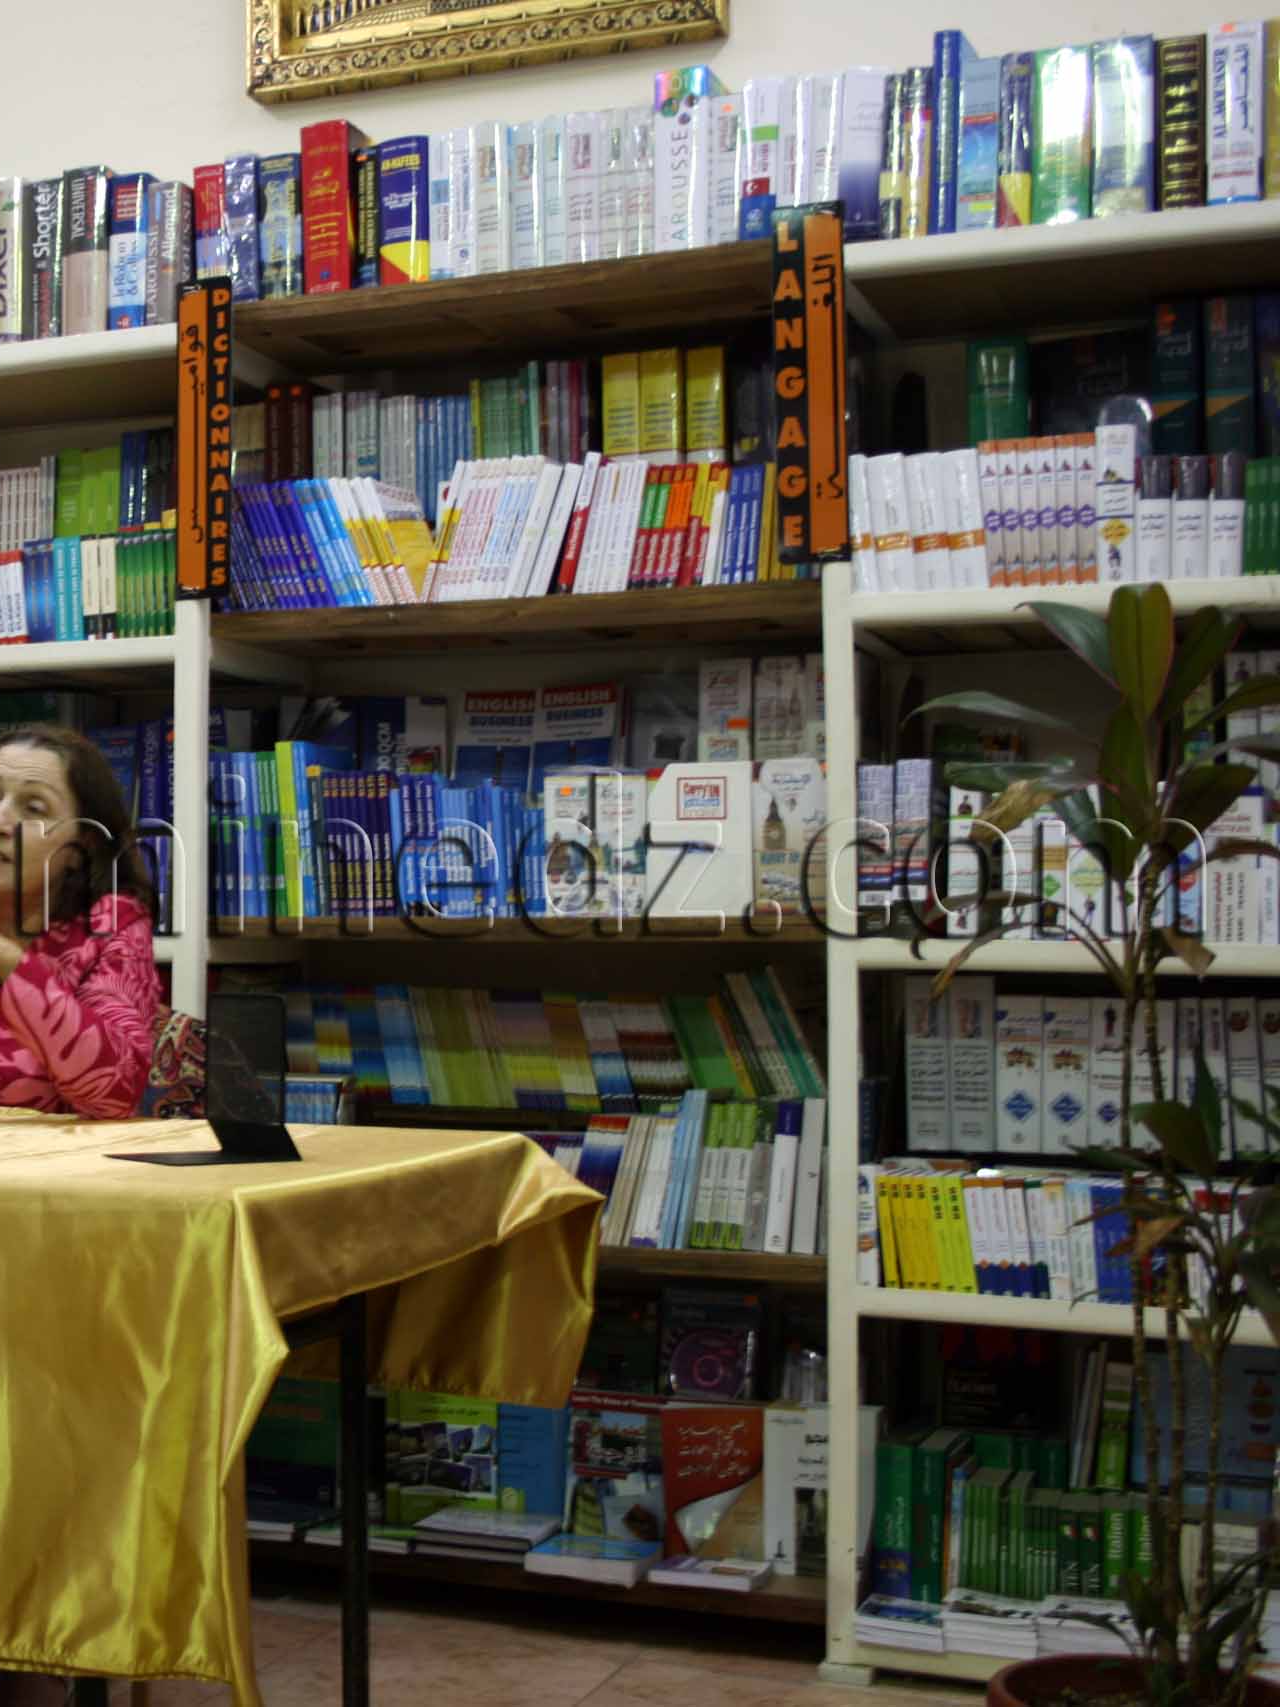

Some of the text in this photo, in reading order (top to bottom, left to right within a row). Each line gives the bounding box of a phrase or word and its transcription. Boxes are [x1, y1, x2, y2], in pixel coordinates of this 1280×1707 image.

[31, 183, 54, 259] Shorter
[160, 189, 177, 259] Allemand
[668, 124, 690, 242] AROUSSE
[210, 288, 231, 587] DICTIONNAIRES
[773, 220, 808, 547] LANGAGE
